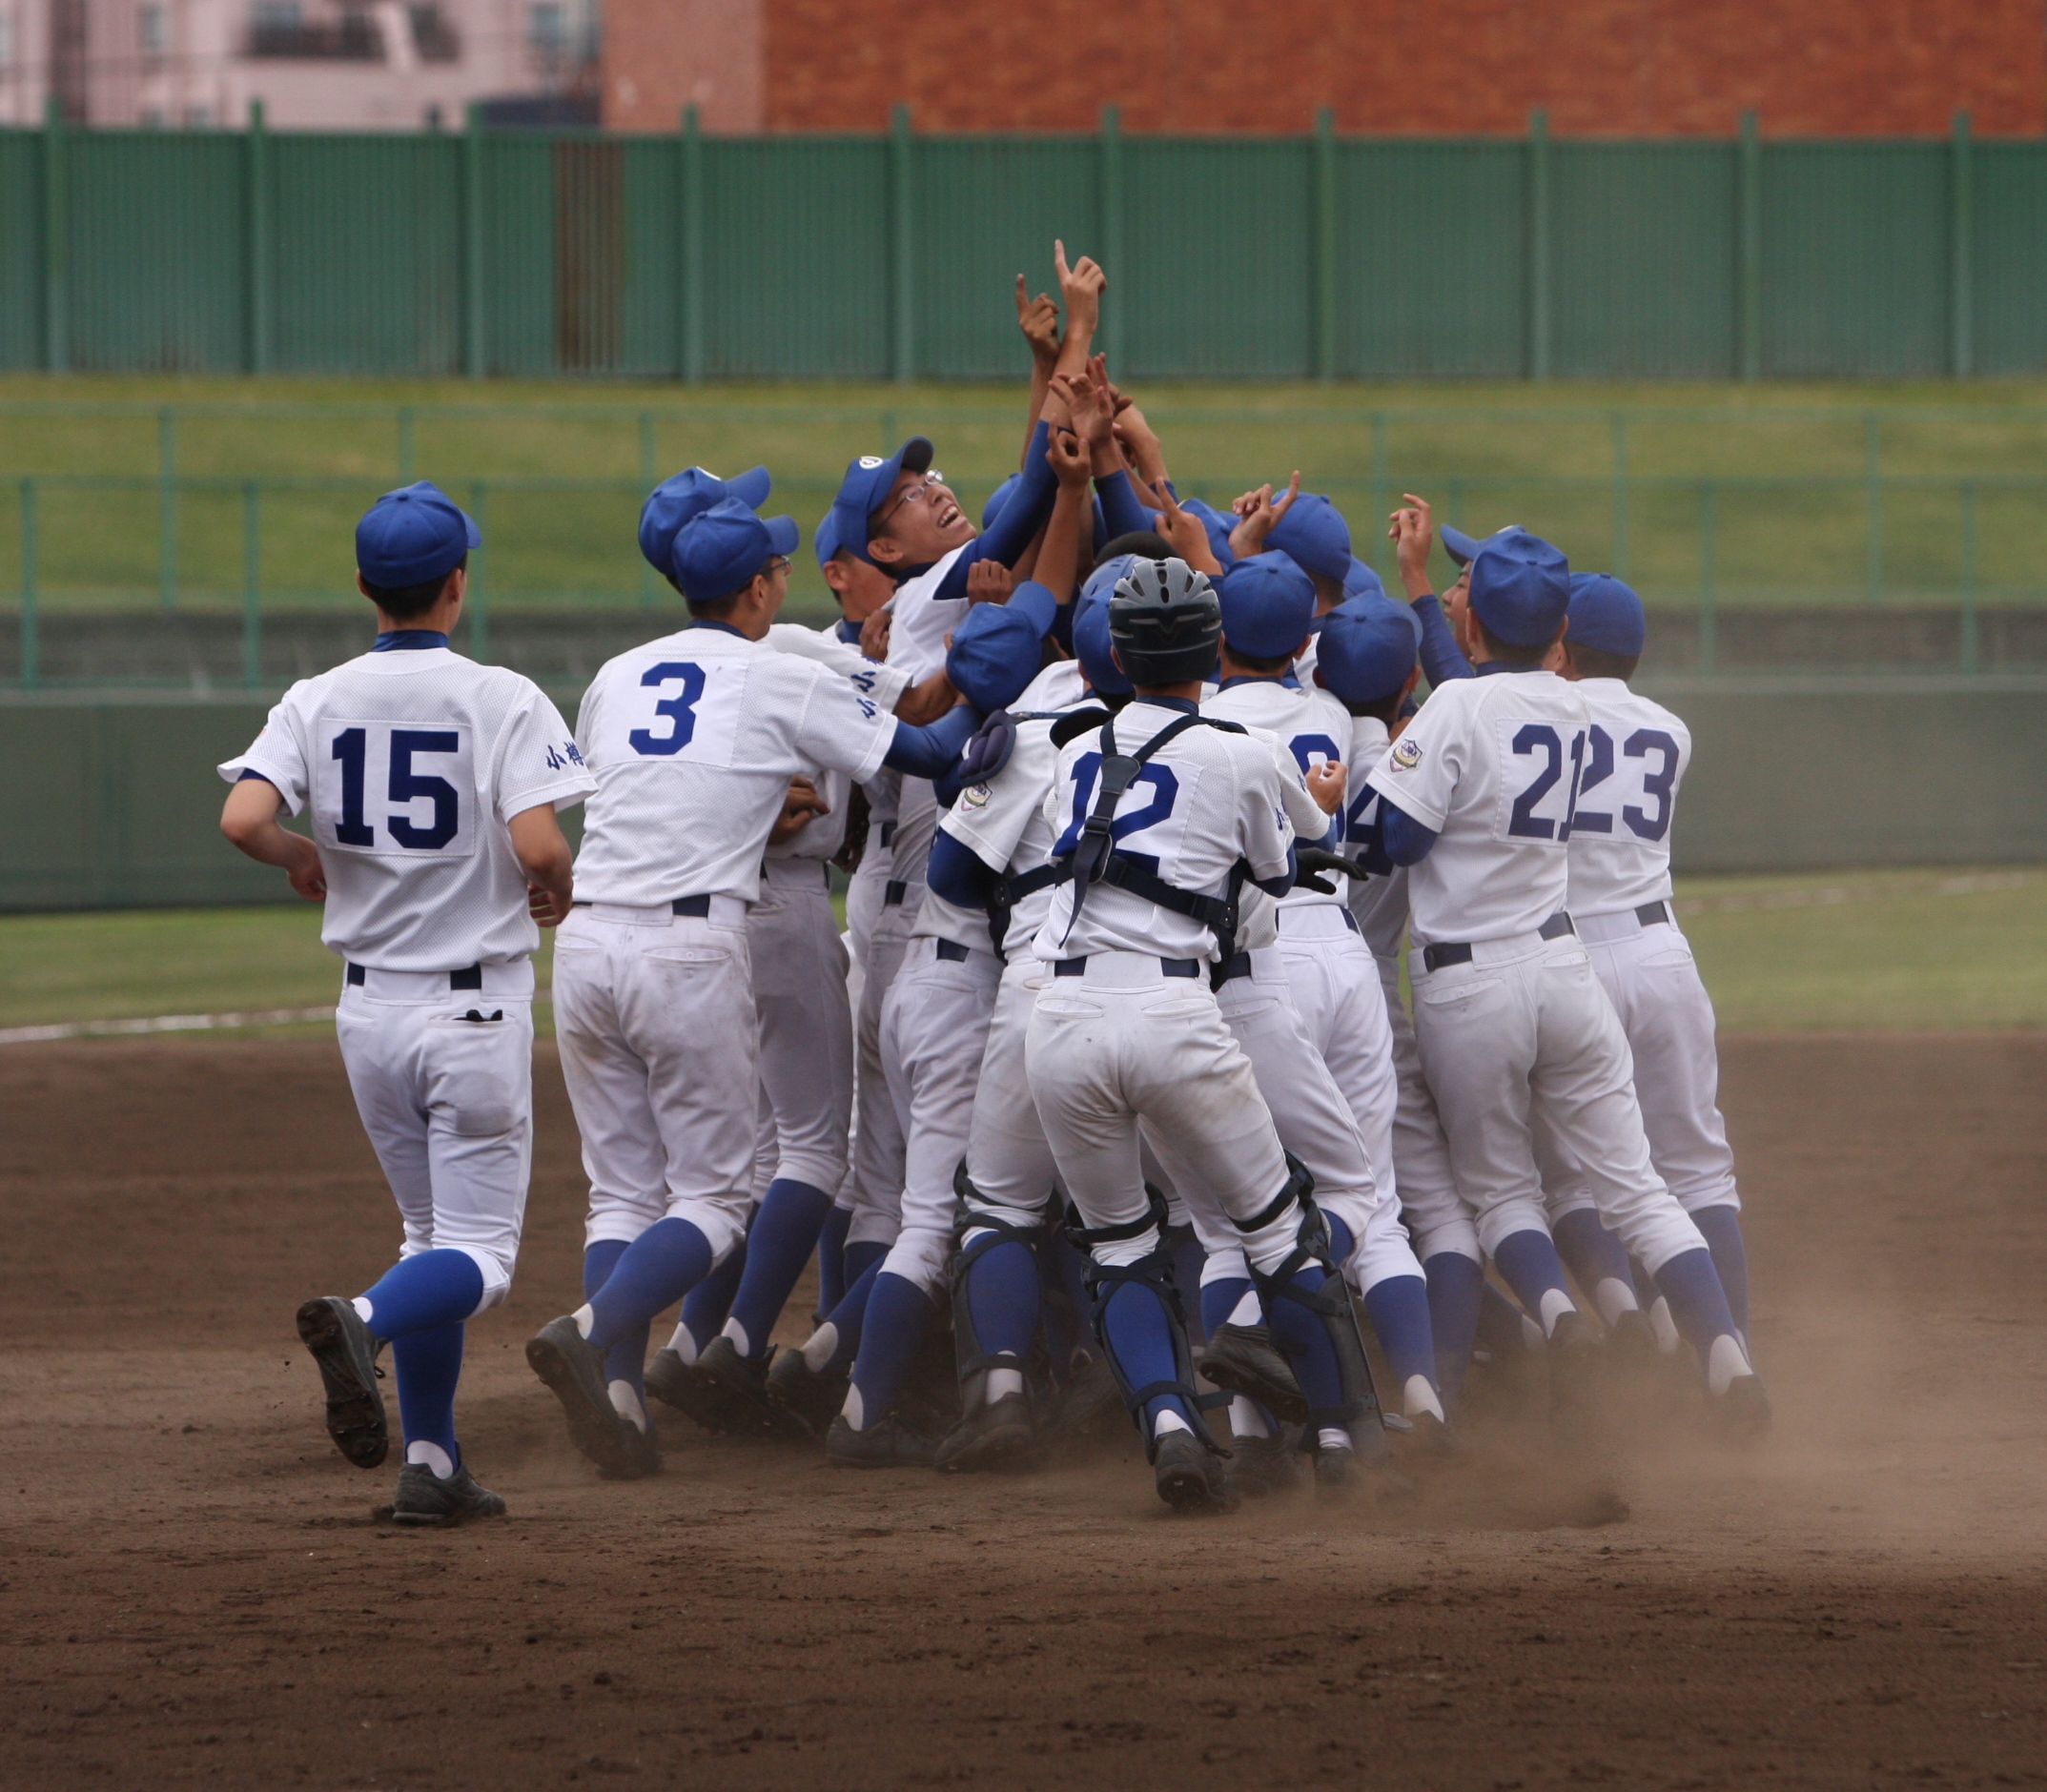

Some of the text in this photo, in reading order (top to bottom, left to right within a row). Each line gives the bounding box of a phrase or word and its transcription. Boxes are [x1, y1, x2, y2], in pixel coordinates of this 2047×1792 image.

[628, 662, 706, 755] 3
[332, 727, 459, 849] 15
[1052, 751, 1179, 876] 12
[1570, 723, 1679, 842] 23
